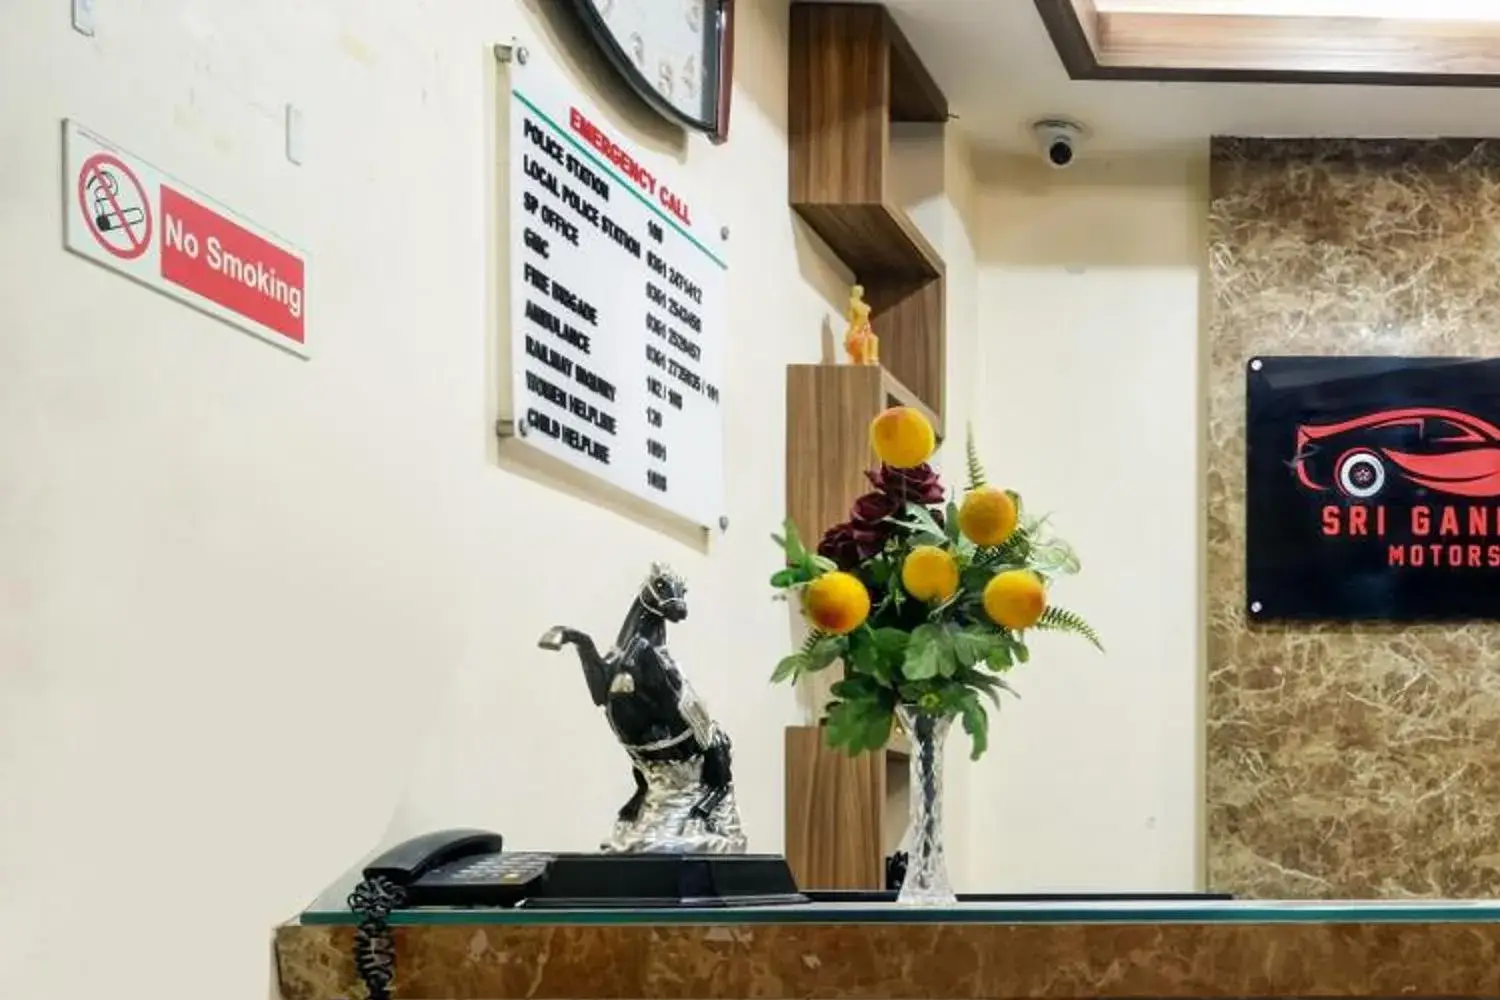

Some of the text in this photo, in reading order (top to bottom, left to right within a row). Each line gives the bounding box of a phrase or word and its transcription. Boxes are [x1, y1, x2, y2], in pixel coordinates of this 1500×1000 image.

[524, 118, 564, 165] POLICE
[566, 153, 609, 202] STATION
[569, 107, 692, 225] EMERGENCY CALL
[524, 154, 560, 197] LOCAL
[562, 184, 599, 227] POLICE
[601, 214, 641, 259] STATION
[524, 191, 538, 214] SP
[541, 205, 579, 246] OFFICE
[165, 213, 302, 317] No Smoking
[524, 262, 550, 295] FIRE
[525, 299, 590, 354] AMBULANCE
[525, 334, 573, 377] RAILWAY
[527, 408, 560, 438] CHILD
[562, 424, 610, 464] HELPLINE
[570, 394, 616, 435] HELPLINE
[1322, 505, 1385, 536] SRI
